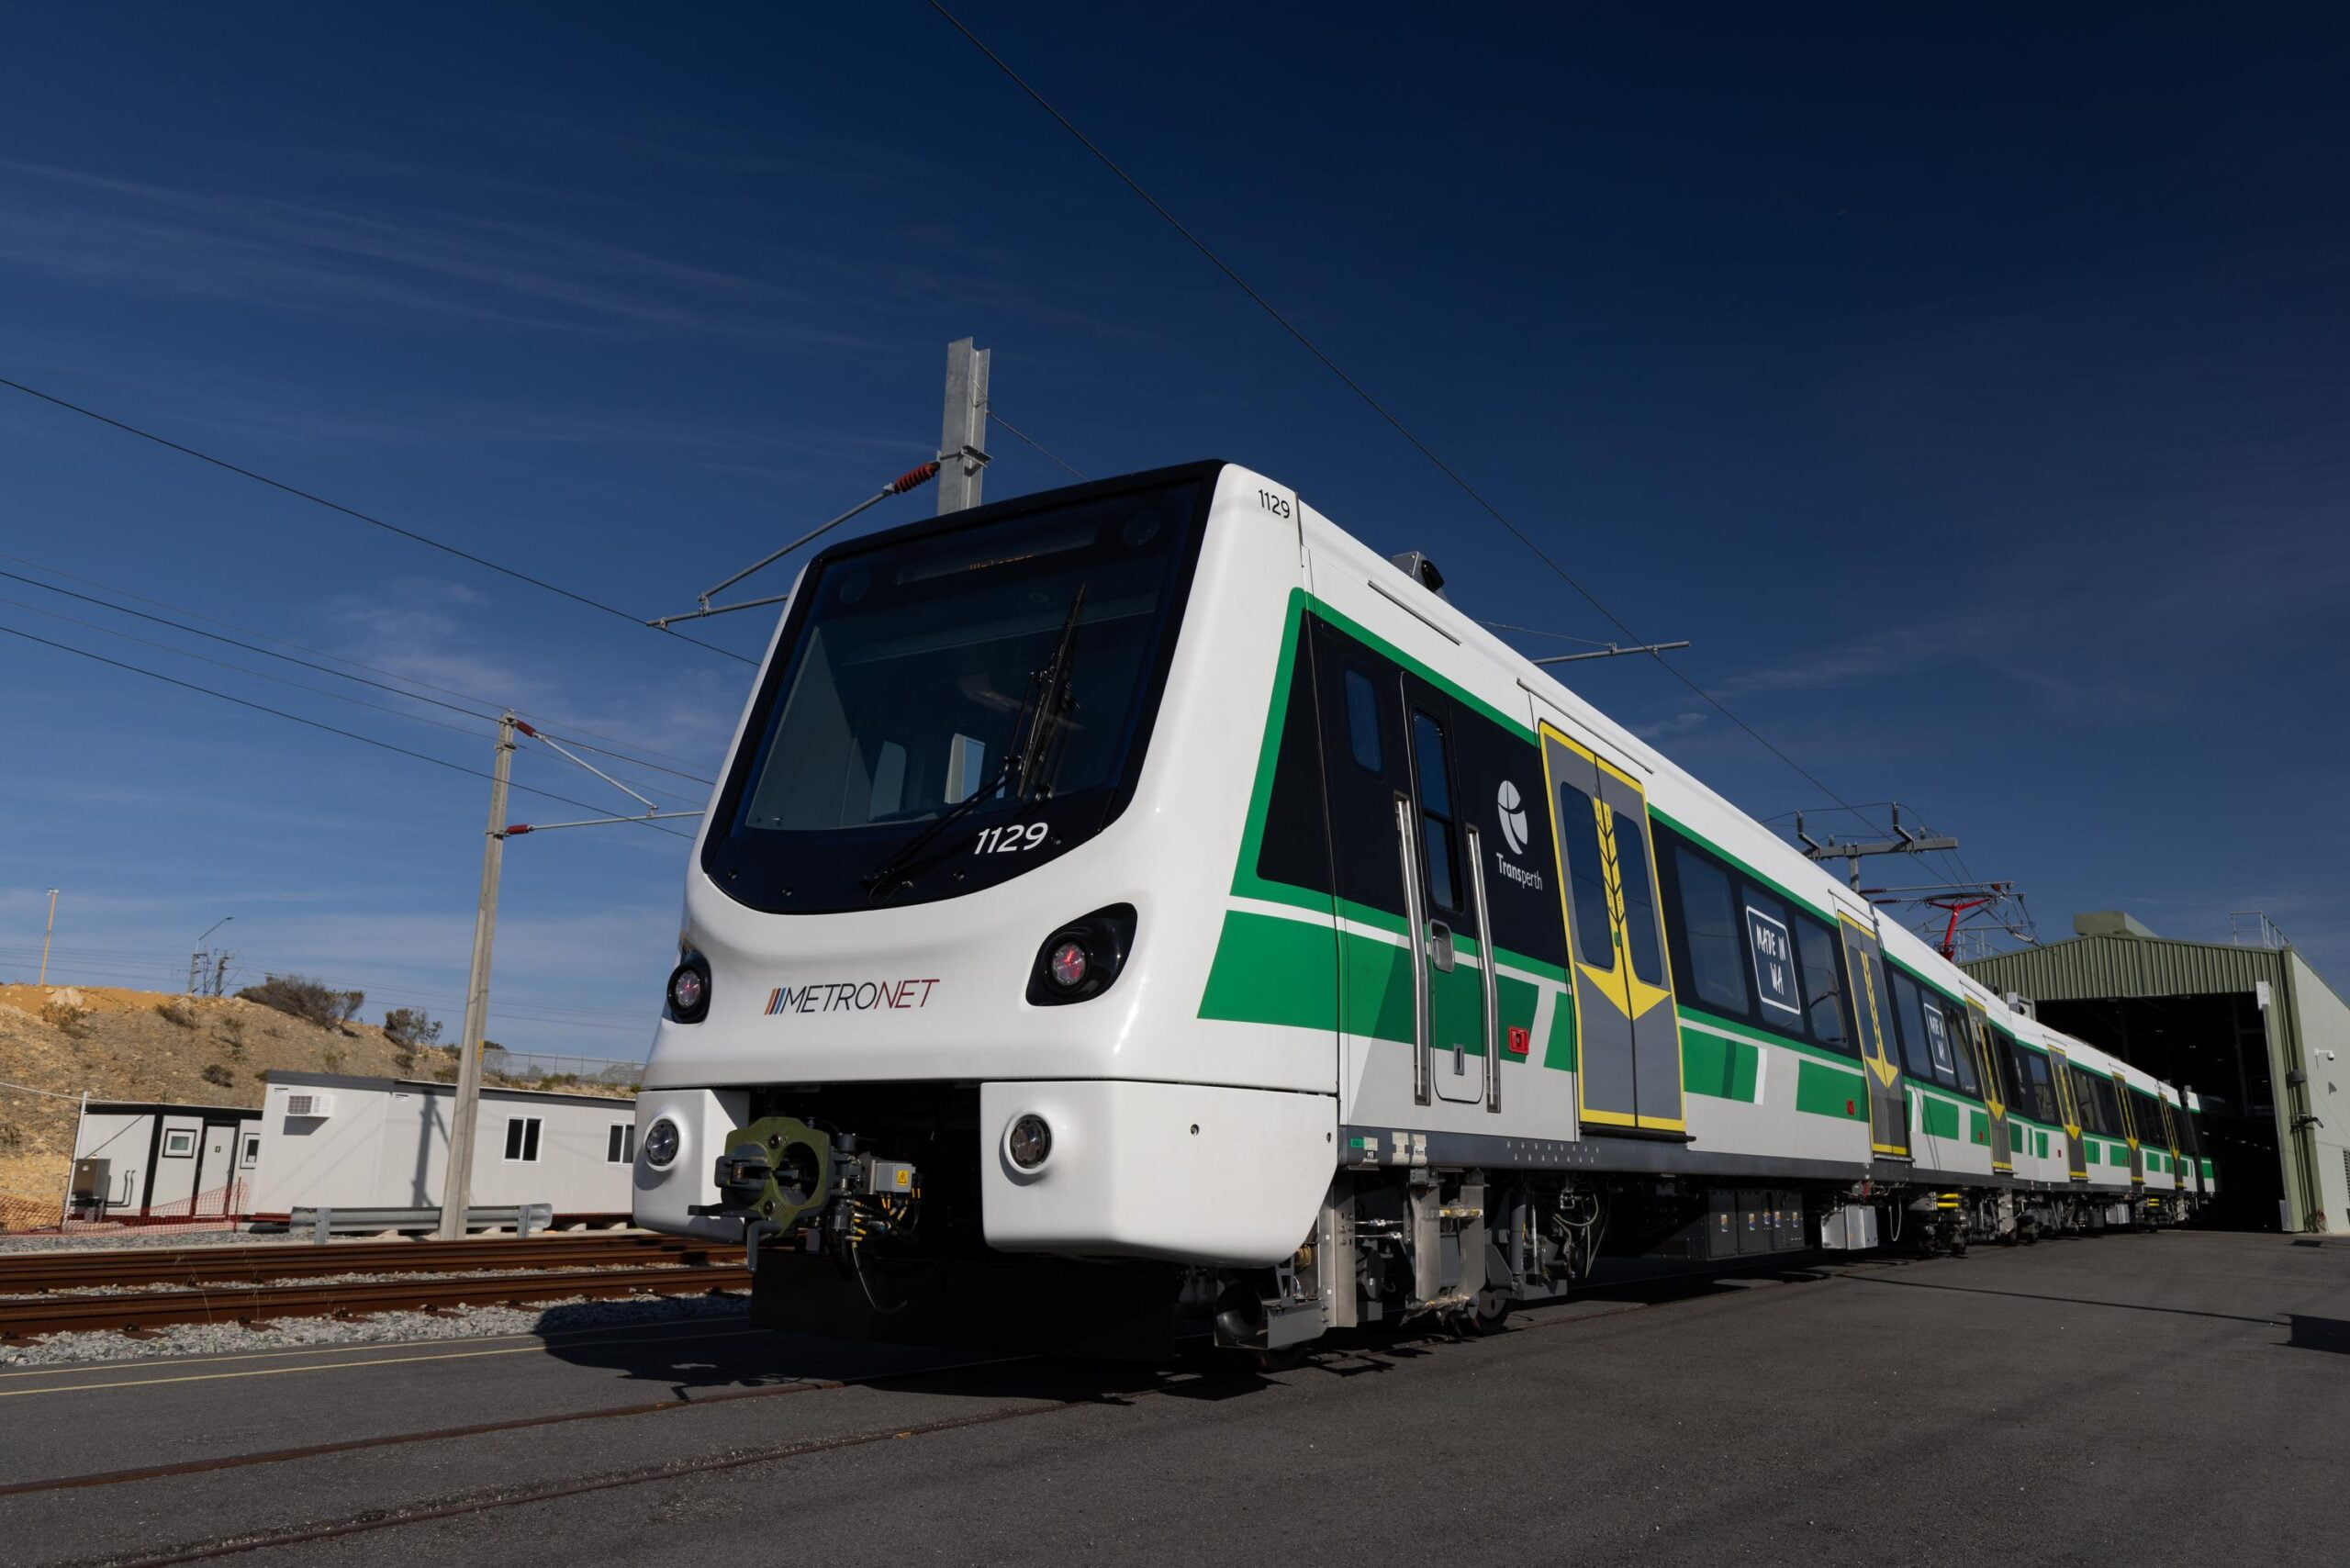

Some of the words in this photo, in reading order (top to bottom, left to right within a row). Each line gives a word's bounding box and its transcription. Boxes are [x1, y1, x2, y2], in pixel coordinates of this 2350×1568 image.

[1258, 489, 1291, 519] 1129
[974, 822, 1048, 855] 1129
[1495, 852, 1543, 890] Transperth
[1756, 923, 1776, 957] MADE
[1778, 936, 1786, 962] IN
[1770, 962, 1785, 996] WA
[779, 979, 941, 1014] METRONET
